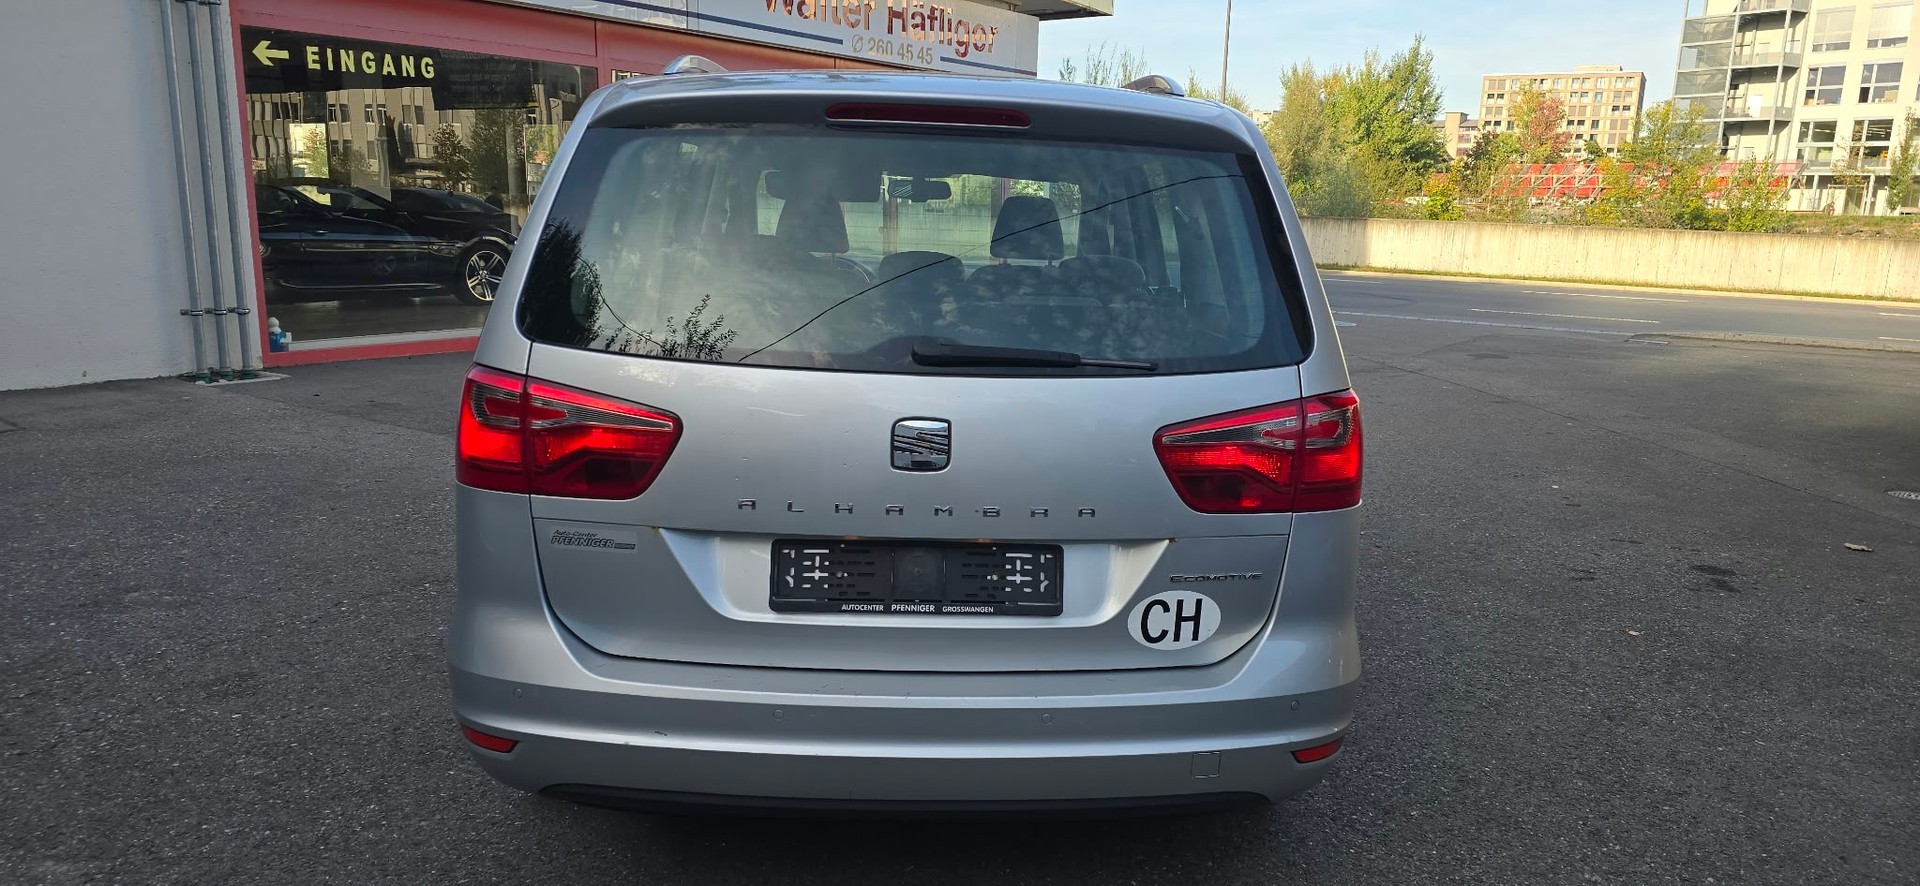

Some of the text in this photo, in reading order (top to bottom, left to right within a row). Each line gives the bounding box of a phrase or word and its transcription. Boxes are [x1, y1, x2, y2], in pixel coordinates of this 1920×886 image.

[886, 0, 999, 58] Häfliger
[306, 45, 435, 79] EINGANG
[867, 37, 934, 65] 260 45 45
[737, 498, 1097, 518] ALHAMBRA
[551, 535, 614, 548] PFENNIGER
[841, 603, 994, 614] AUTOCENTER PFENNIGER GROSSWANGEN
[1140, 598, 1203, 644] CH
